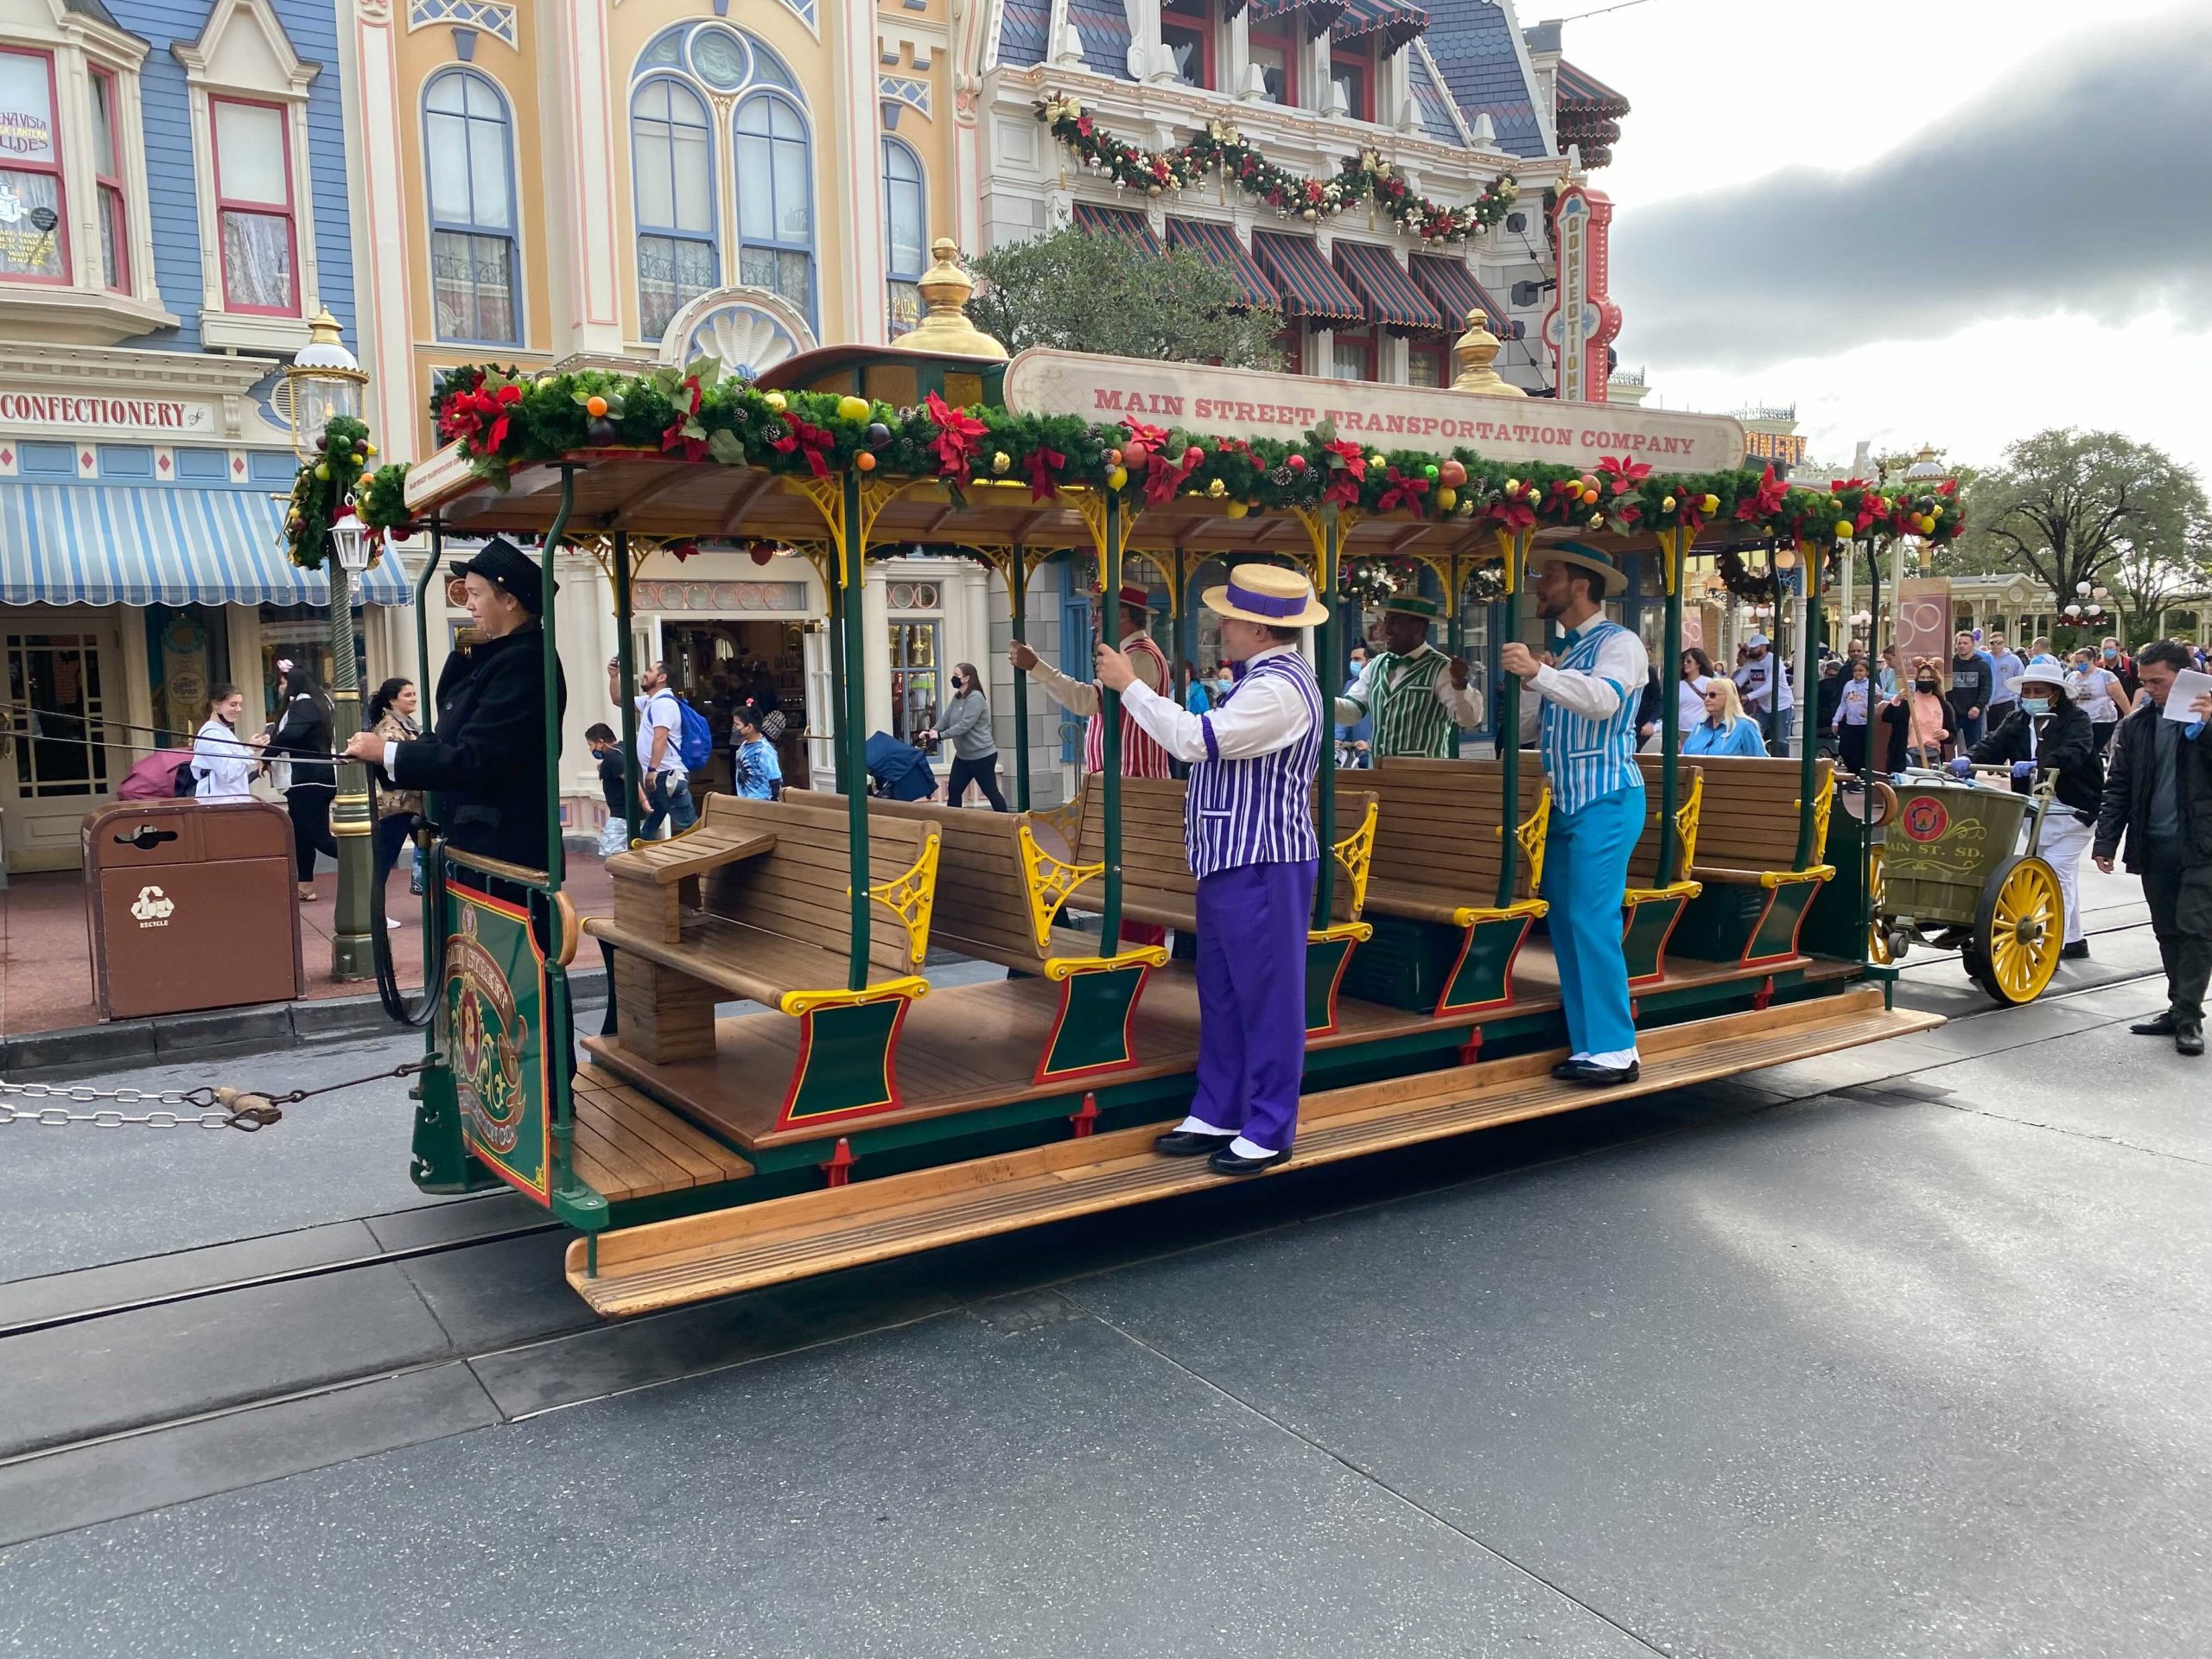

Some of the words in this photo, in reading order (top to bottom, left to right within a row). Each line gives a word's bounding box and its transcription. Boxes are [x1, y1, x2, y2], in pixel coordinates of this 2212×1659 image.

[0, 394, 186, 428] CONFECTIONERY
[1094, 389, 1185, 416] MAIN
[1195, 397, 1315, 426] STREET
[1325, 410, 1573, 445] TRANSPORTATION
[1580, 429, 1694, 454] COMPANY
[1899, 601, 1942, 648] 50
[1919, 844, 1946, 855] ST.
[1955, 848, 1985, 858] SD.
[139, 919, 169, 929] RECYCLE
